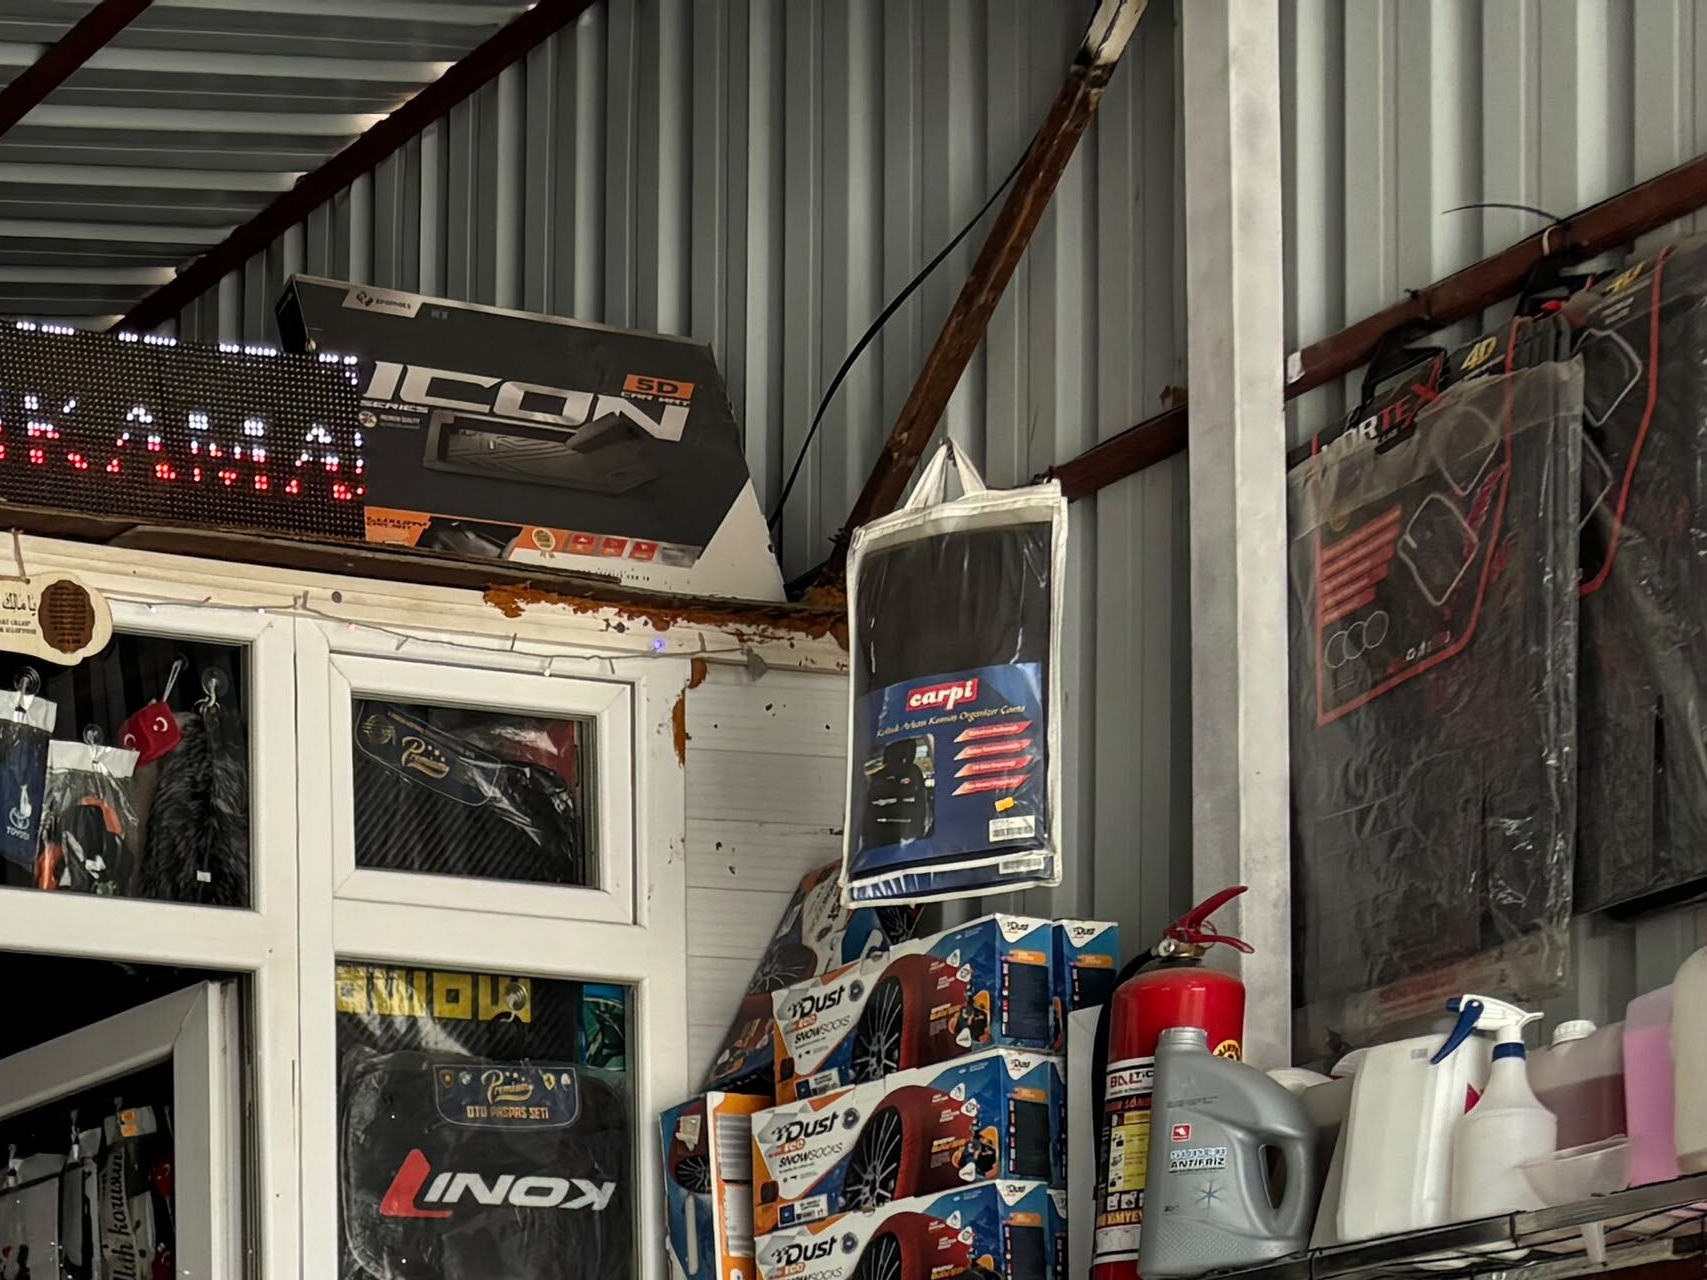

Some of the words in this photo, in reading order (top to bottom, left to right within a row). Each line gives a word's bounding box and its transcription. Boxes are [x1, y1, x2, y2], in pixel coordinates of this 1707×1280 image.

[1462, 337, 1497, 369] 4D
[363, 361, 690, 441] ICON
[637, 378, 679, 394] 5D
[360, 400, 429, 413] SERIES
[909, 681, 974, 710] carpi
[798, 984, 846, 1018] Dust
[794, 1014, 851, 1046] SNOWSOCKS
[482, 1069, 535, 1105] Premium
[786, 1112, 839, 1141] Dust
[779, 1142, 843, 1168] SNOWSOCKS
[424, 1172, 616, 1211] KONI
[786, 1235, 837, 1265] Dust
